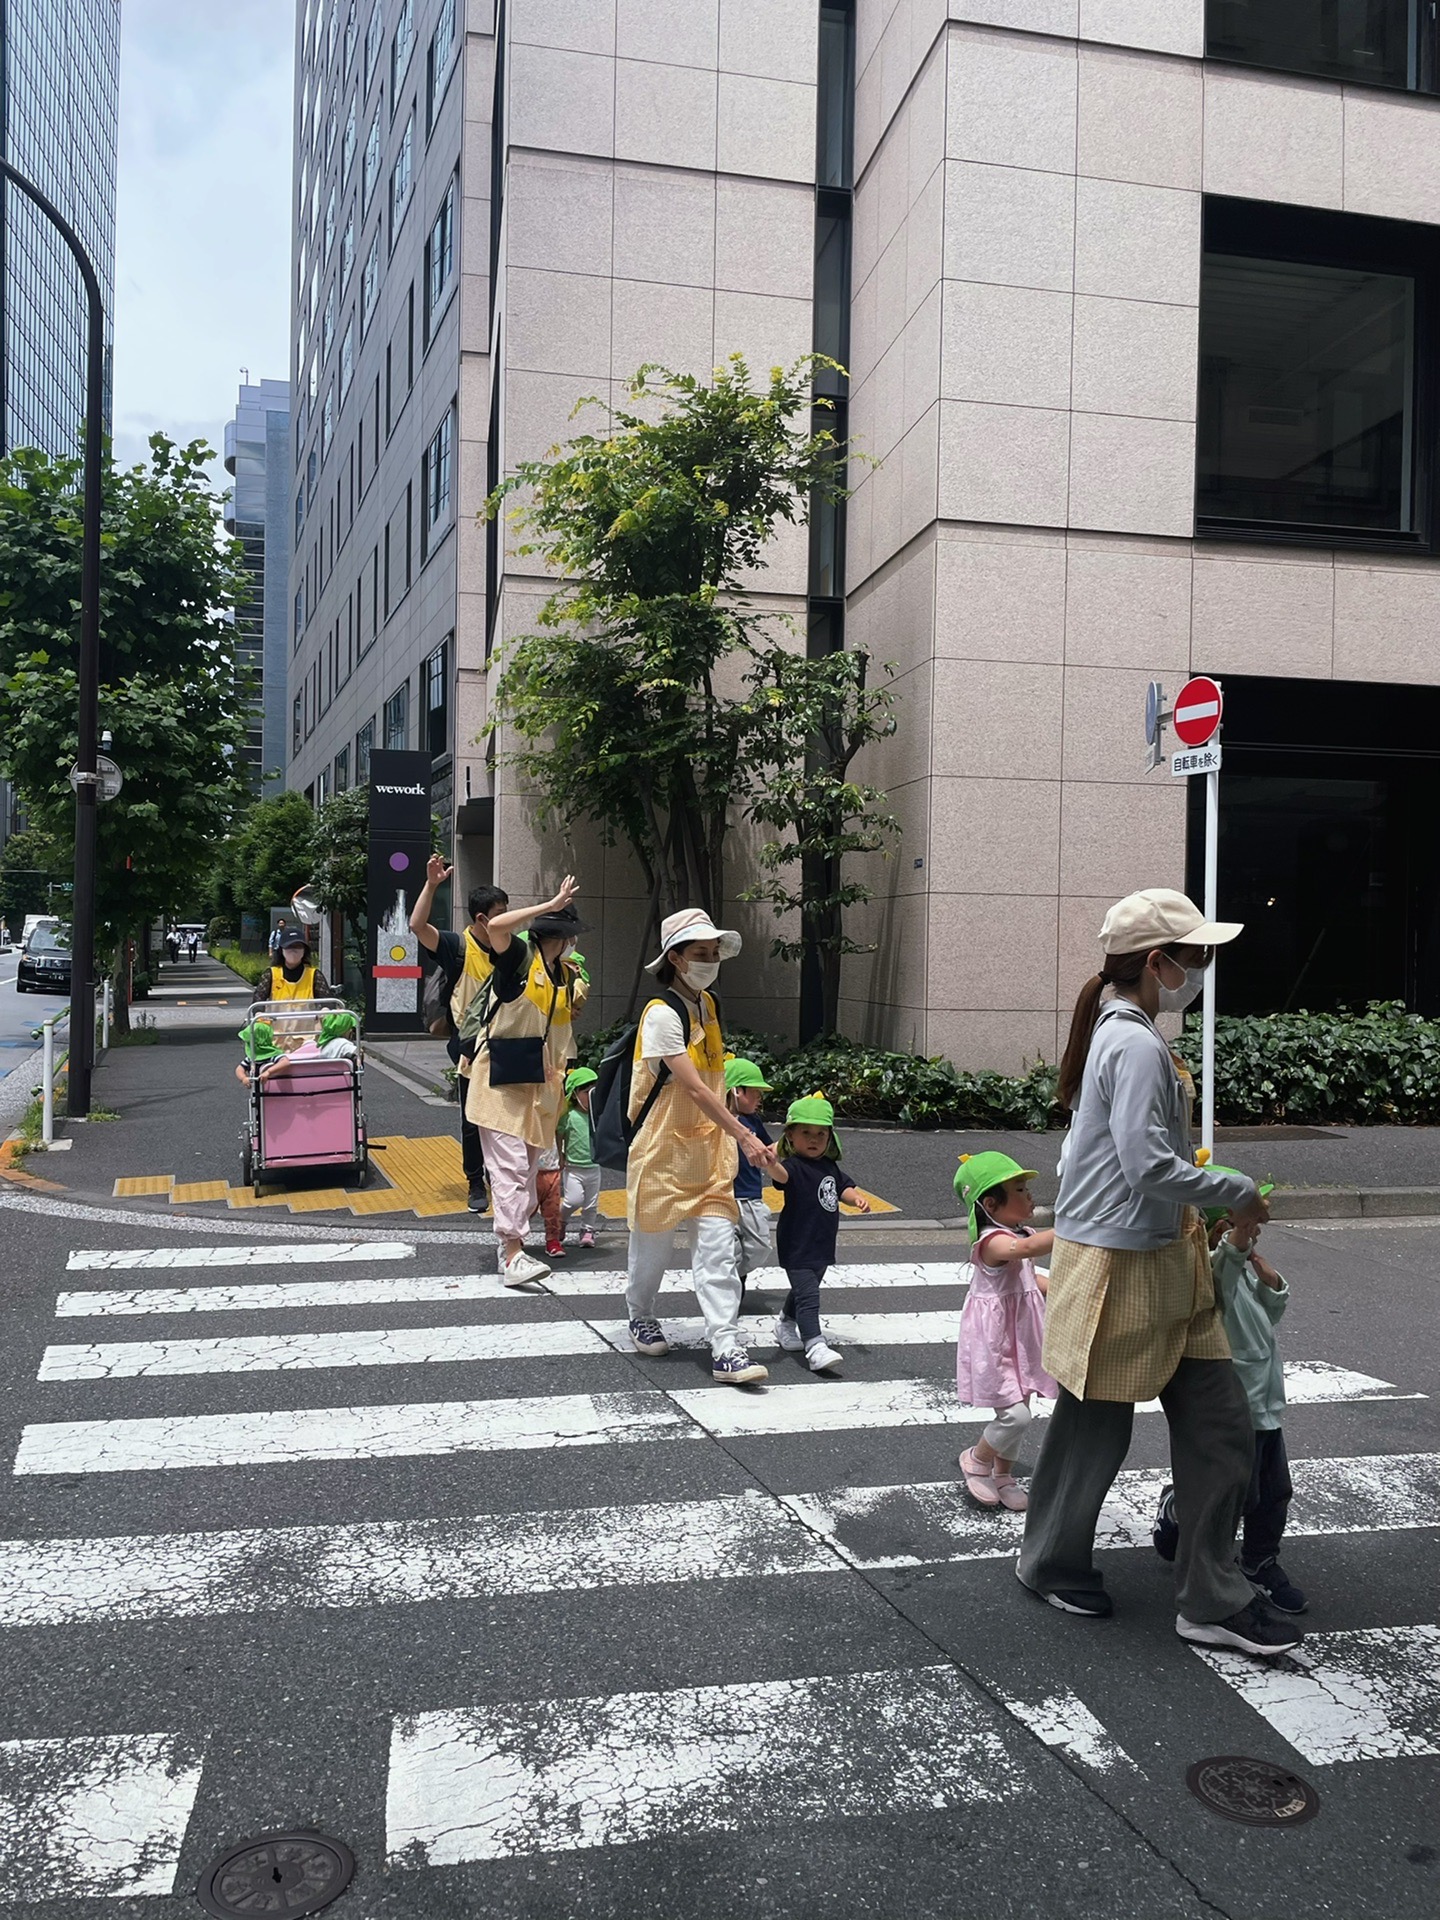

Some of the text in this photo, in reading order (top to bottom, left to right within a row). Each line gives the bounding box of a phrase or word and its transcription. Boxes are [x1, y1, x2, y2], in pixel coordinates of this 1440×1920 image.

[1174, 752, 1217, 772] 自転車を除く
[375, 783, 426, 795] wework
